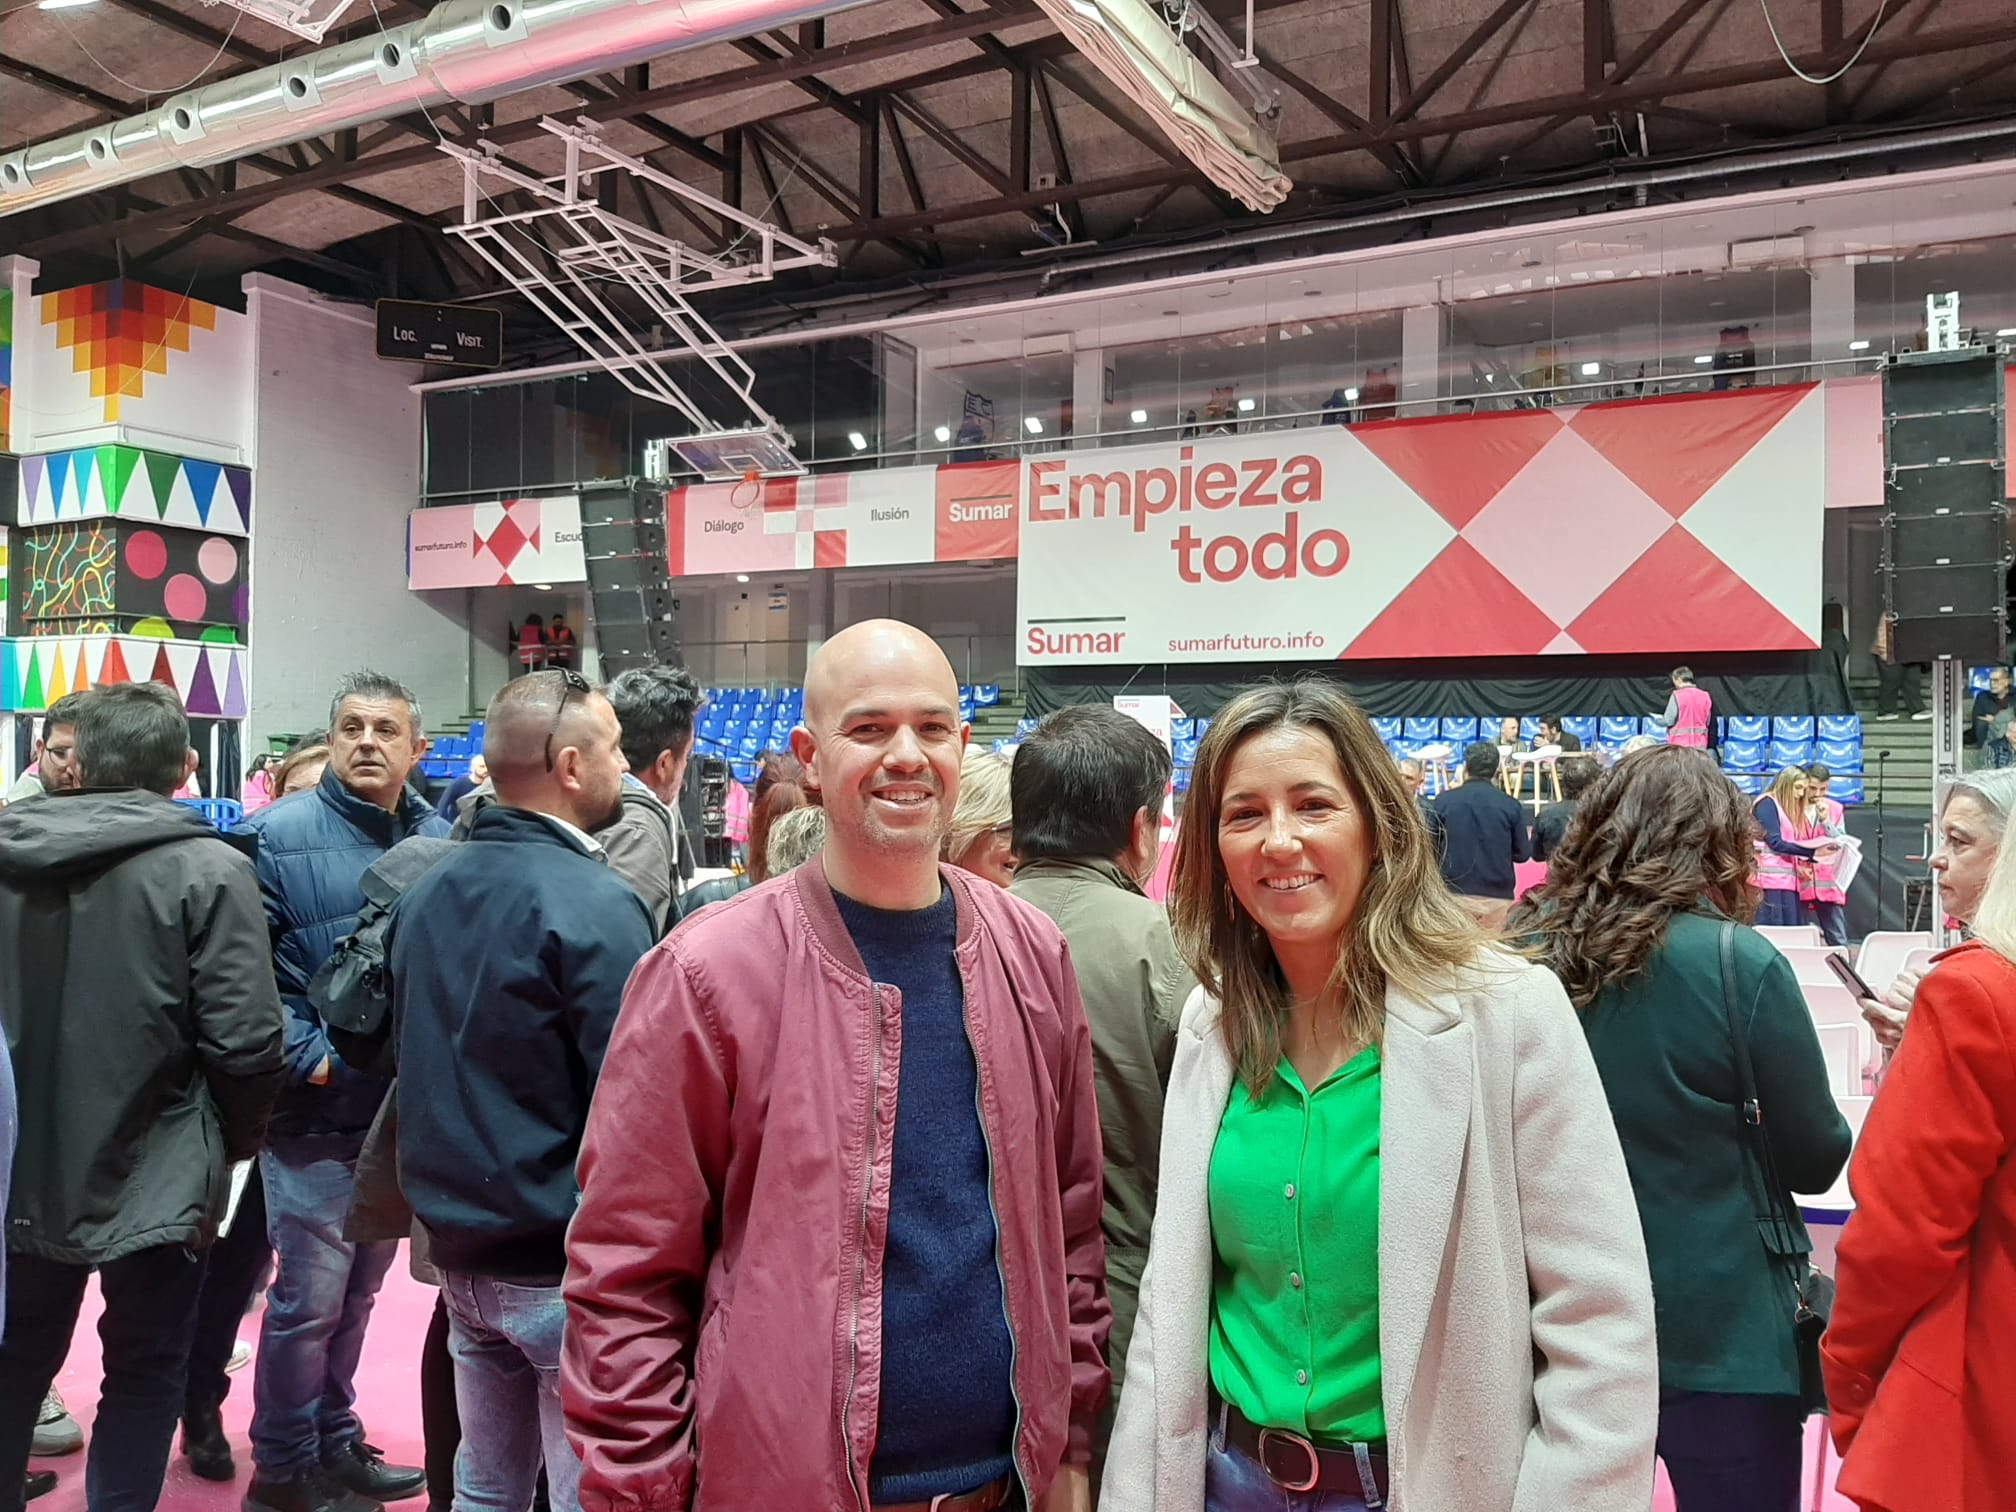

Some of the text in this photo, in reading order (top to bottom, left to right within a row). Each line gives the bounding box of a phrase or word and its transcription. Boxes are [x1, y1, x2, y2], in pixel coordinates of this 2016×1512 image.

[1028, 446, 1322, 532] Empieza
[871, 508, 910, 521] Ilusión
[949, 501, 1013, 523] Sumar
[704, 520, 744, 534] Diálogo
[1170, 512, 1350, 583] todo
[1027, 626, 1126, 655] Sumar
[1168, 631, 1324, 652] sumarfuturo.info
